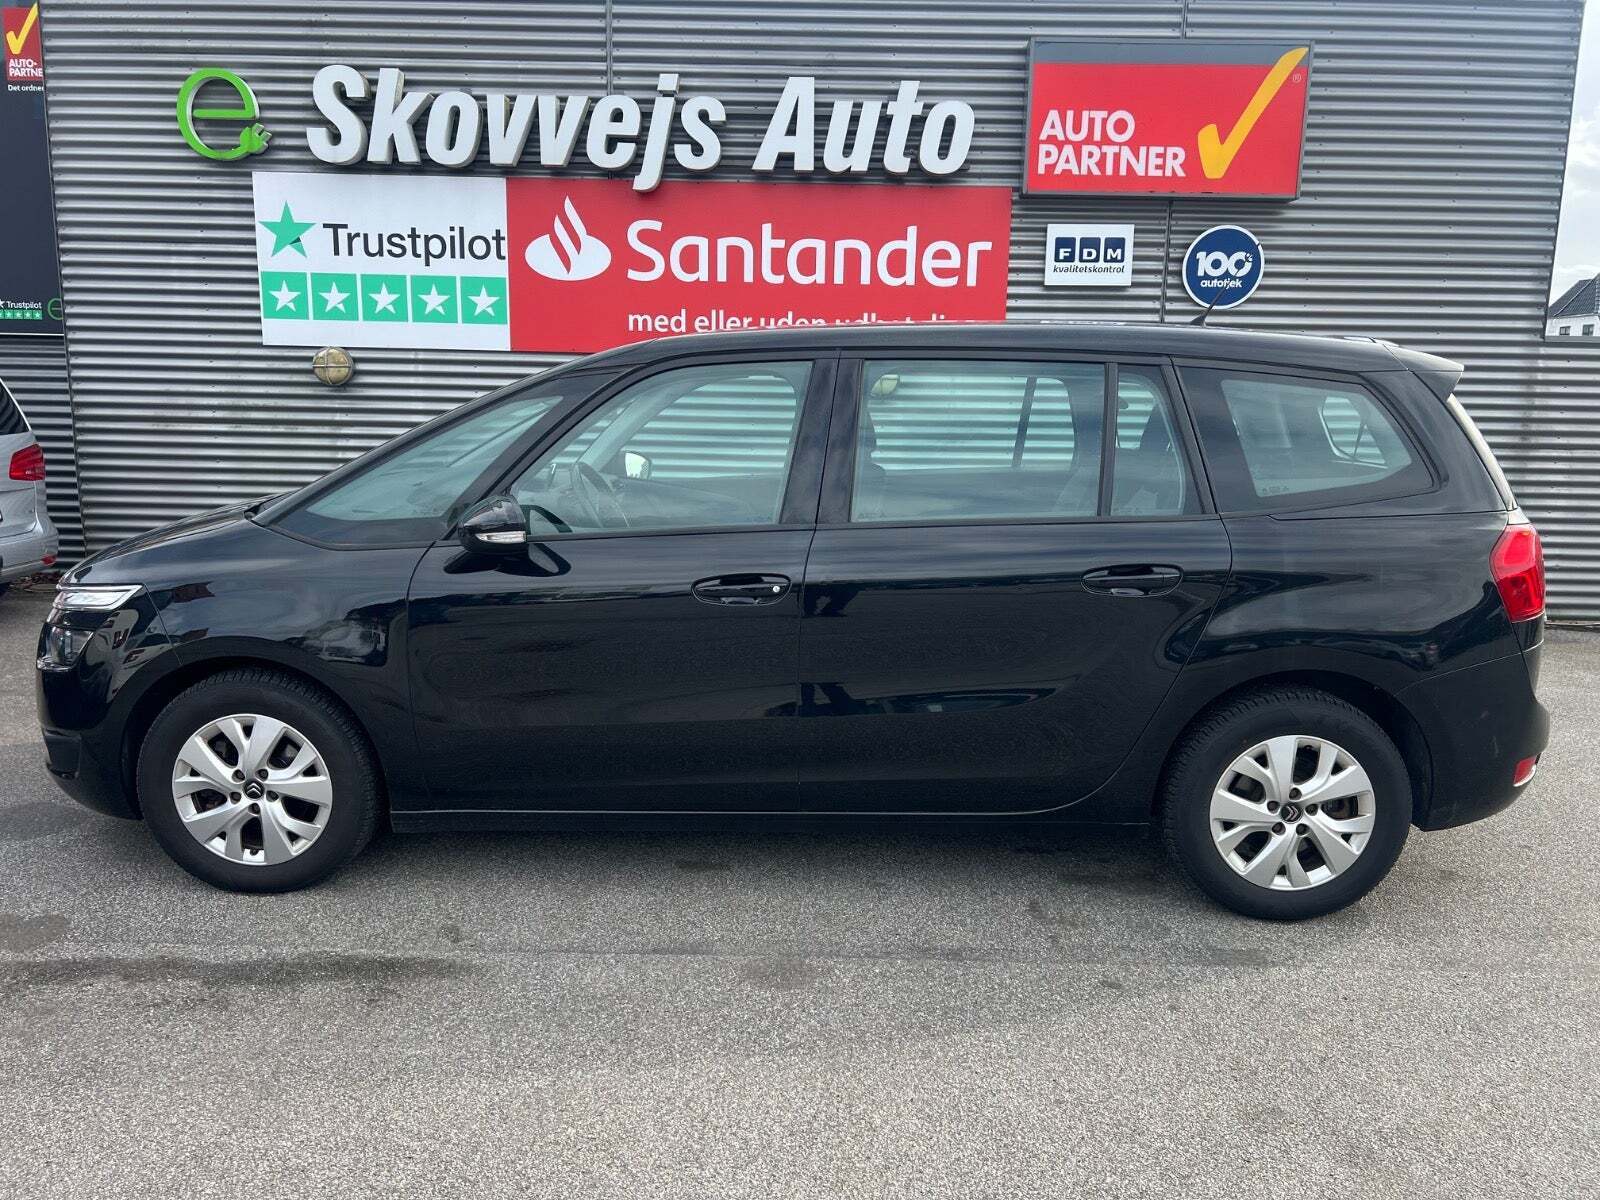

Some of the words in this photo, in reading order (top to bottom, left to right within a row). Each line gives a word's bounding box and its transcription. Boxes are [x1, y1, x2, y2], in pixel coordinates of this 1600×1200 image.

[8, 84, 20, 92] Det
[306, 65, 727, 192] Skovvejs
[751, 76, 976, 176] Auto
[1039, 109, 1136, 143] AUTO
[1037, 144, 1187, 178] PARTNER
[322, 222, 507, 267] Trustpilot
[626, 219, 993, 288] Santander
[1053, 264, 1125, 274] kvalitetskontrol
[6, 300, 42, 310] Trustpilot
[628, 308, 687, 333] med
[694, 309, 753, 333] eller
